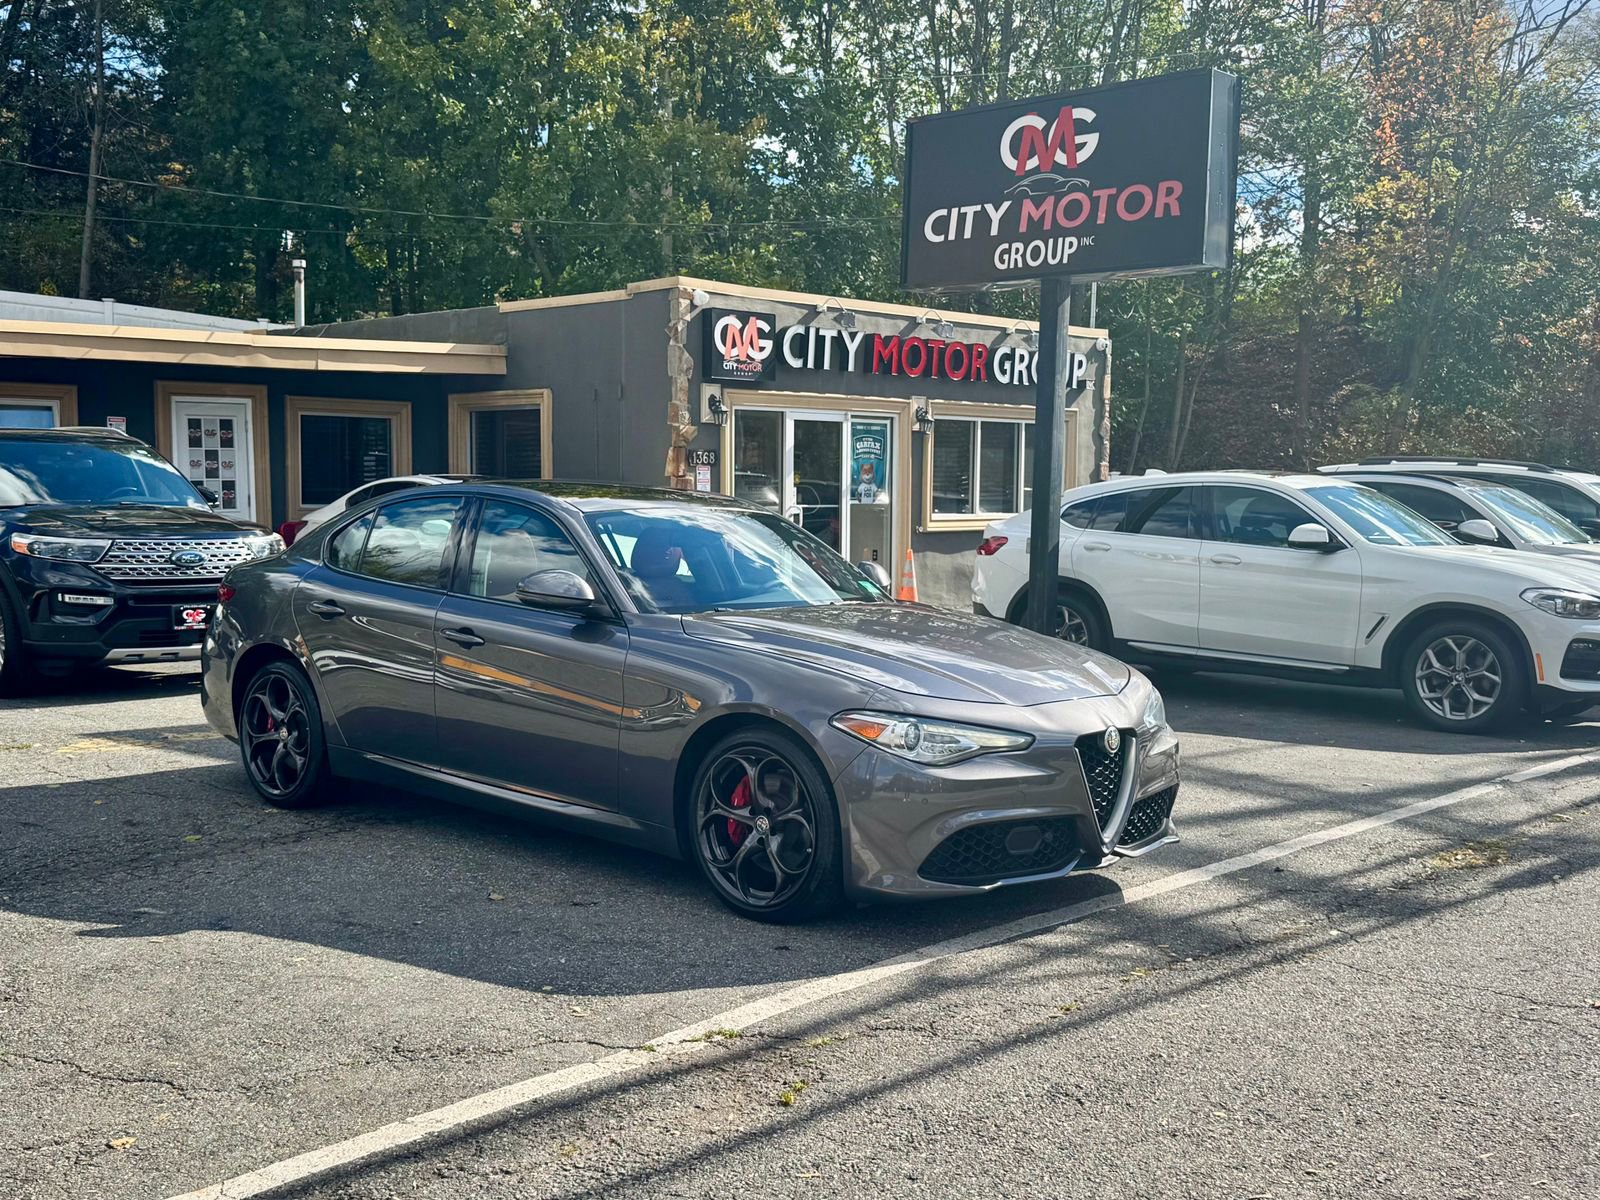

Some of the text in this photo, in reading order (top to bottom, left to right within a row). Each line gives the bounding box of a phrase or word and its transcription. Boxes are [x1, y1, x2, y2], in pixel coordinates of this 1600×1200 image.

[924, 180, 1183, 243] CITY MOTOR
[993, 235, 1095, 270] GROUP INC
[723, 361, 763, 373] CITY MOTOR
[783, 324, 865, 372] CITY
[872, 333, 989, 383] MOTOR
[993, 346, 1088, 389] GRP
[692, 451, 715, 464] 1368
[856, 441, 881, 450] CARFAX
